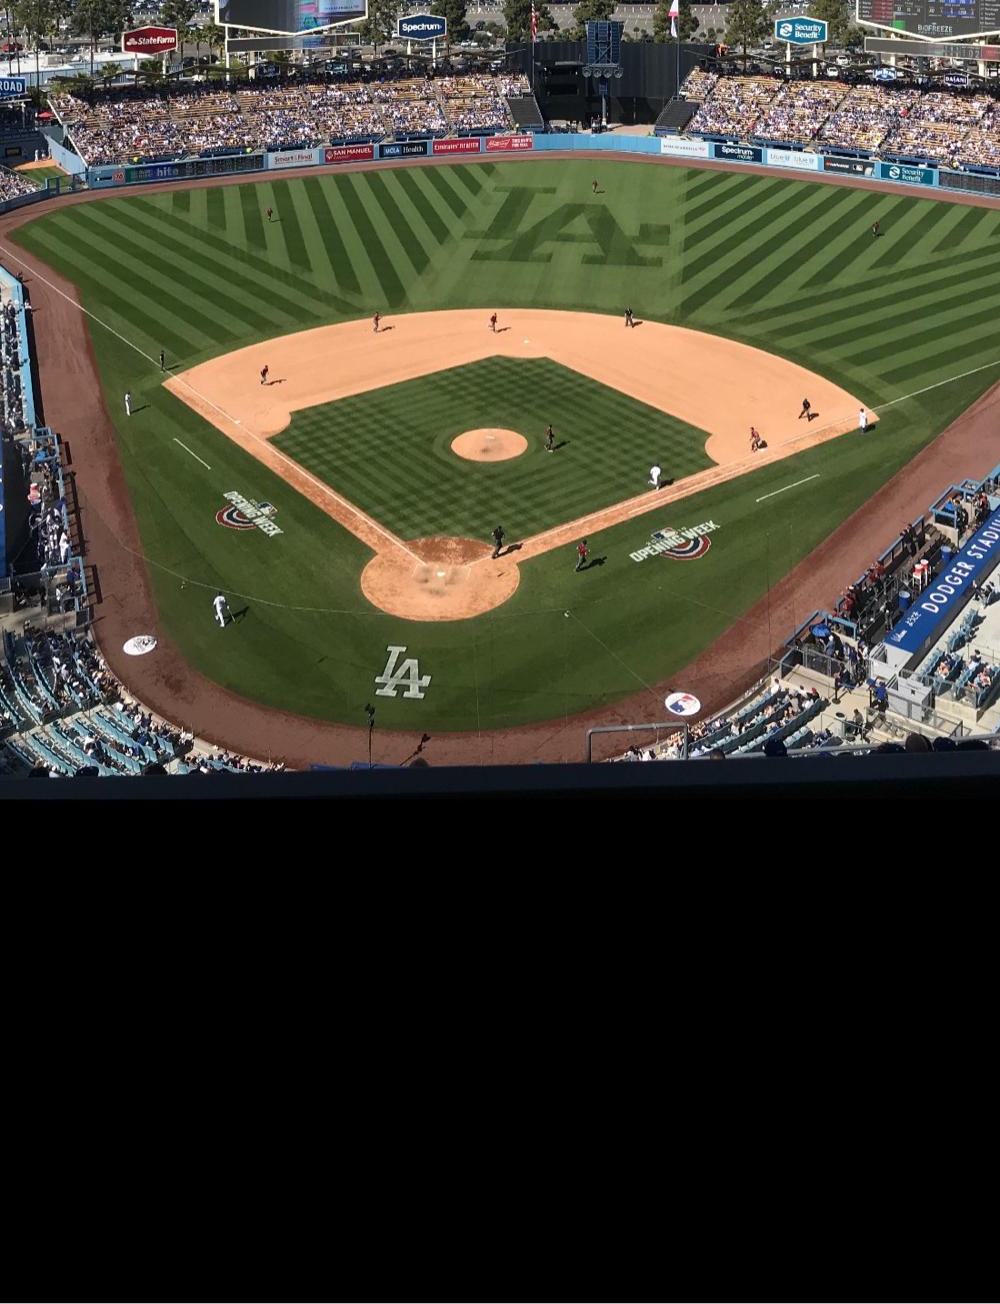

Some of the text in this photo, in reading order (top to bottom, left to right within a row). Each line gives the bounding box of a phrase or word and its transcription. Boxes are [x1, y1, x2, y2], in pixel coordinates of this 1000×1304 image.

[402, 23, 440, 33] Spectrum
[795, 23, 823, 34] Security
[917, 24, 953, 33] BIOFREEZE
[795, 30, 819, 39] Benefit
[347, 147, 372, 155] MANUEL
[402, 145, 424, 154] Health
[721, 145, 753, 156] Spectrum
[901, 167, 924, 177] Security
[902, 174, 921, 182] Benefit
[223, 491, 284, 537] OPENING WEEK
[629, 520, 721, 563] OPENING WEEK
[921, 515, 1000, 614] DODGER STADIU
[374, 645, 432, 699] LA
